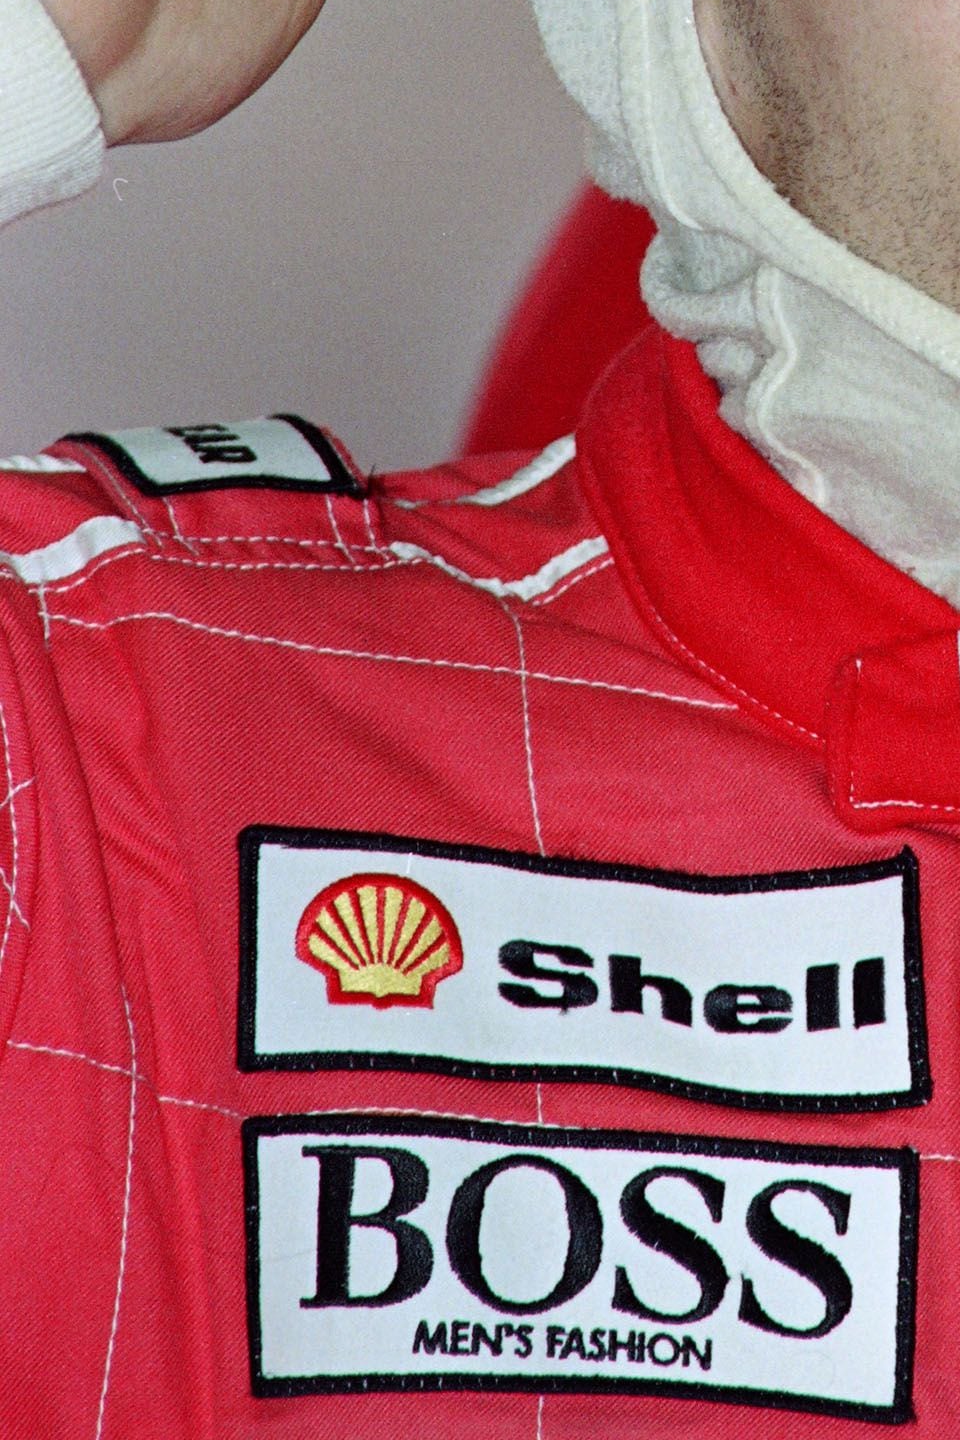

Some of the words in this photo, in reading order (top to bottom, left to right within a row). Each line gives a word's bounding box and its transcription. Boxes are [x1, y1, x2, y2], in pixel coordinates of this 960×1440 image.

[498, 939, 886, 1034] Shell
[300, 1145, 854, 1339] BOSS
[413, 1321, 534, 1359] MEN'S
[547, 1325, 713, 1371] FASHION
